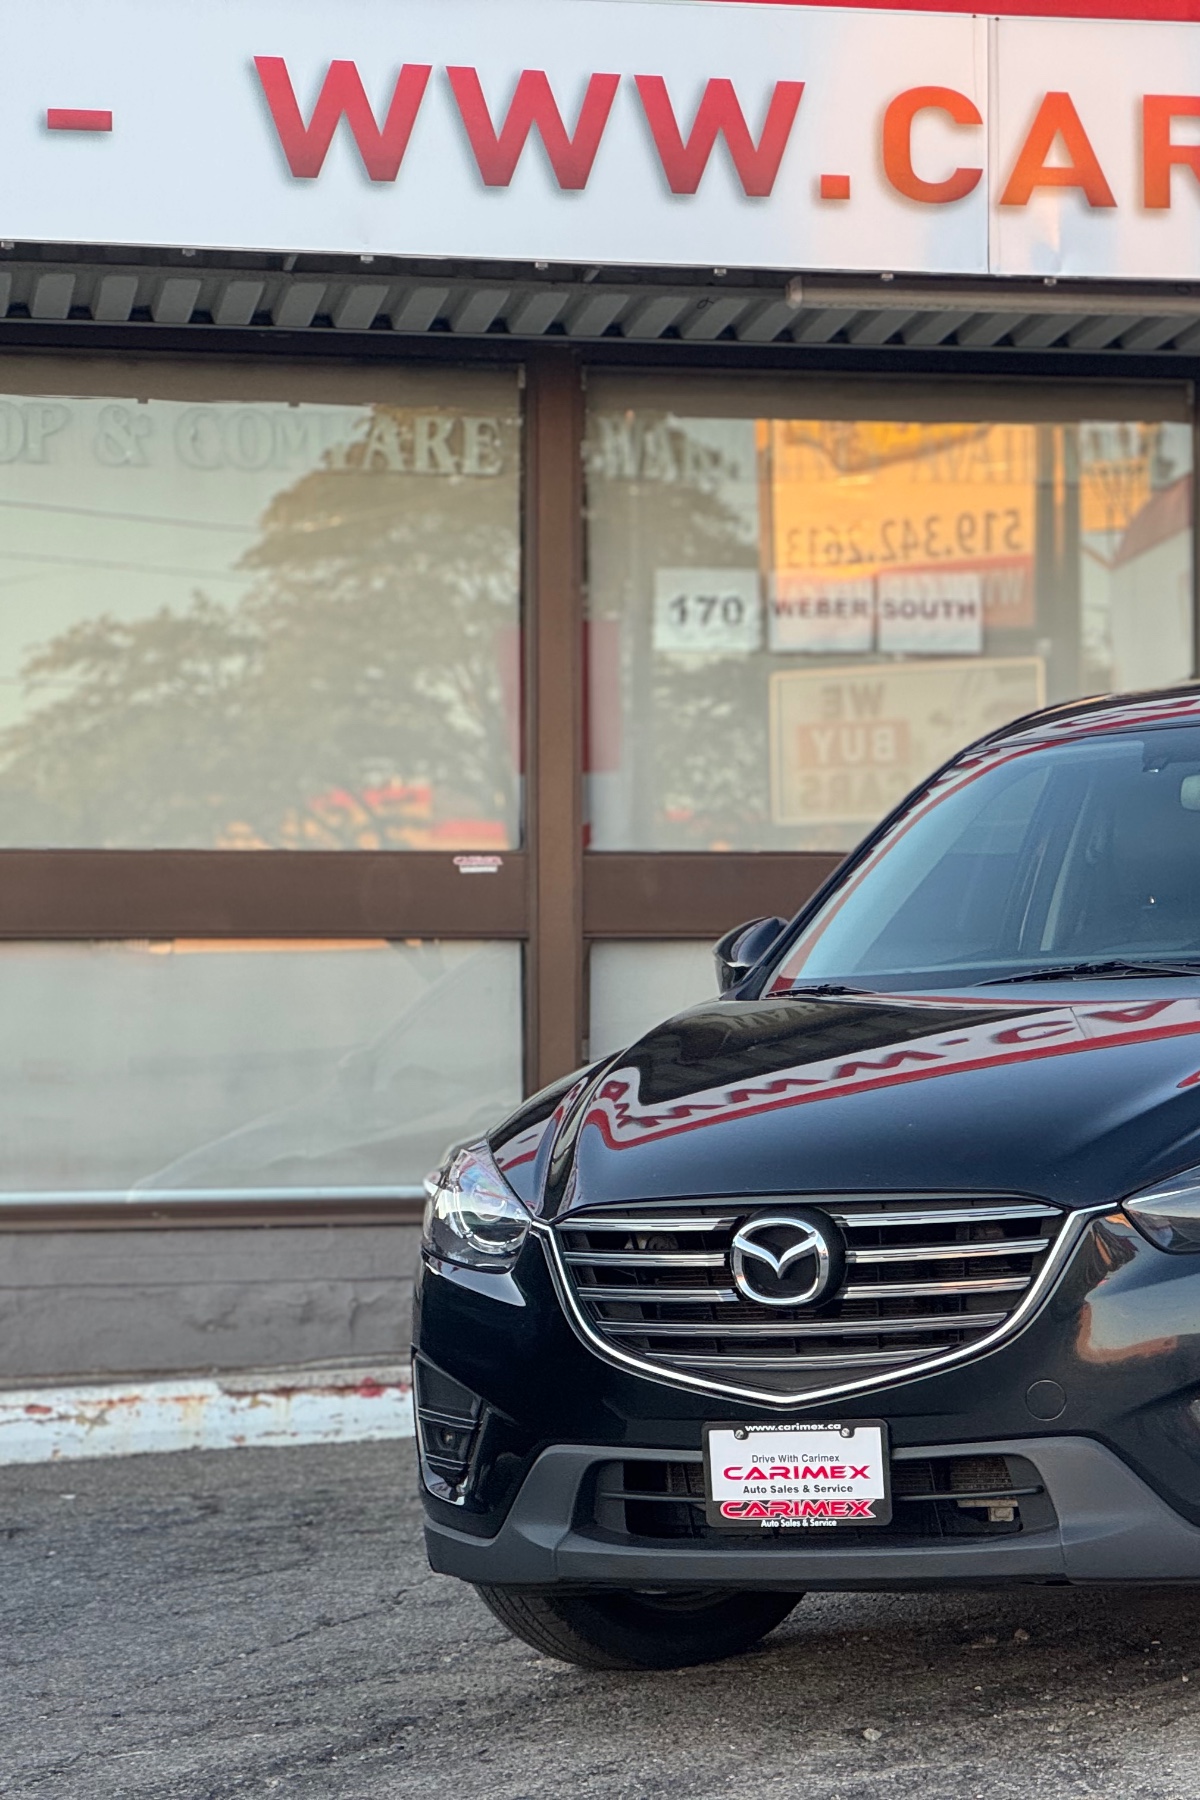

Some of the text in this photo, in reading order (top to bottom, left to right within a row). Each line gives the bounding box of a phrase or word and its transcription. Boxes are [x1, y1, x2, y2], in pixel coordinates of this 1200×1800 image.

[670, 595, 976, 627] 170 WEBER SOUTH
[744, 1423, 842, 1432] www.carimex.ca
[751, 1453, 840, 1464] Drive With Carimex
[723, 1465, 871, 1481] CARIMEX
[743, 1484, 853, 1494] Auto Sales & Service
[720, 1499, 876, 1519] CARIMEX
[761, 1519, 837, 1528] Auto Sales & Service
